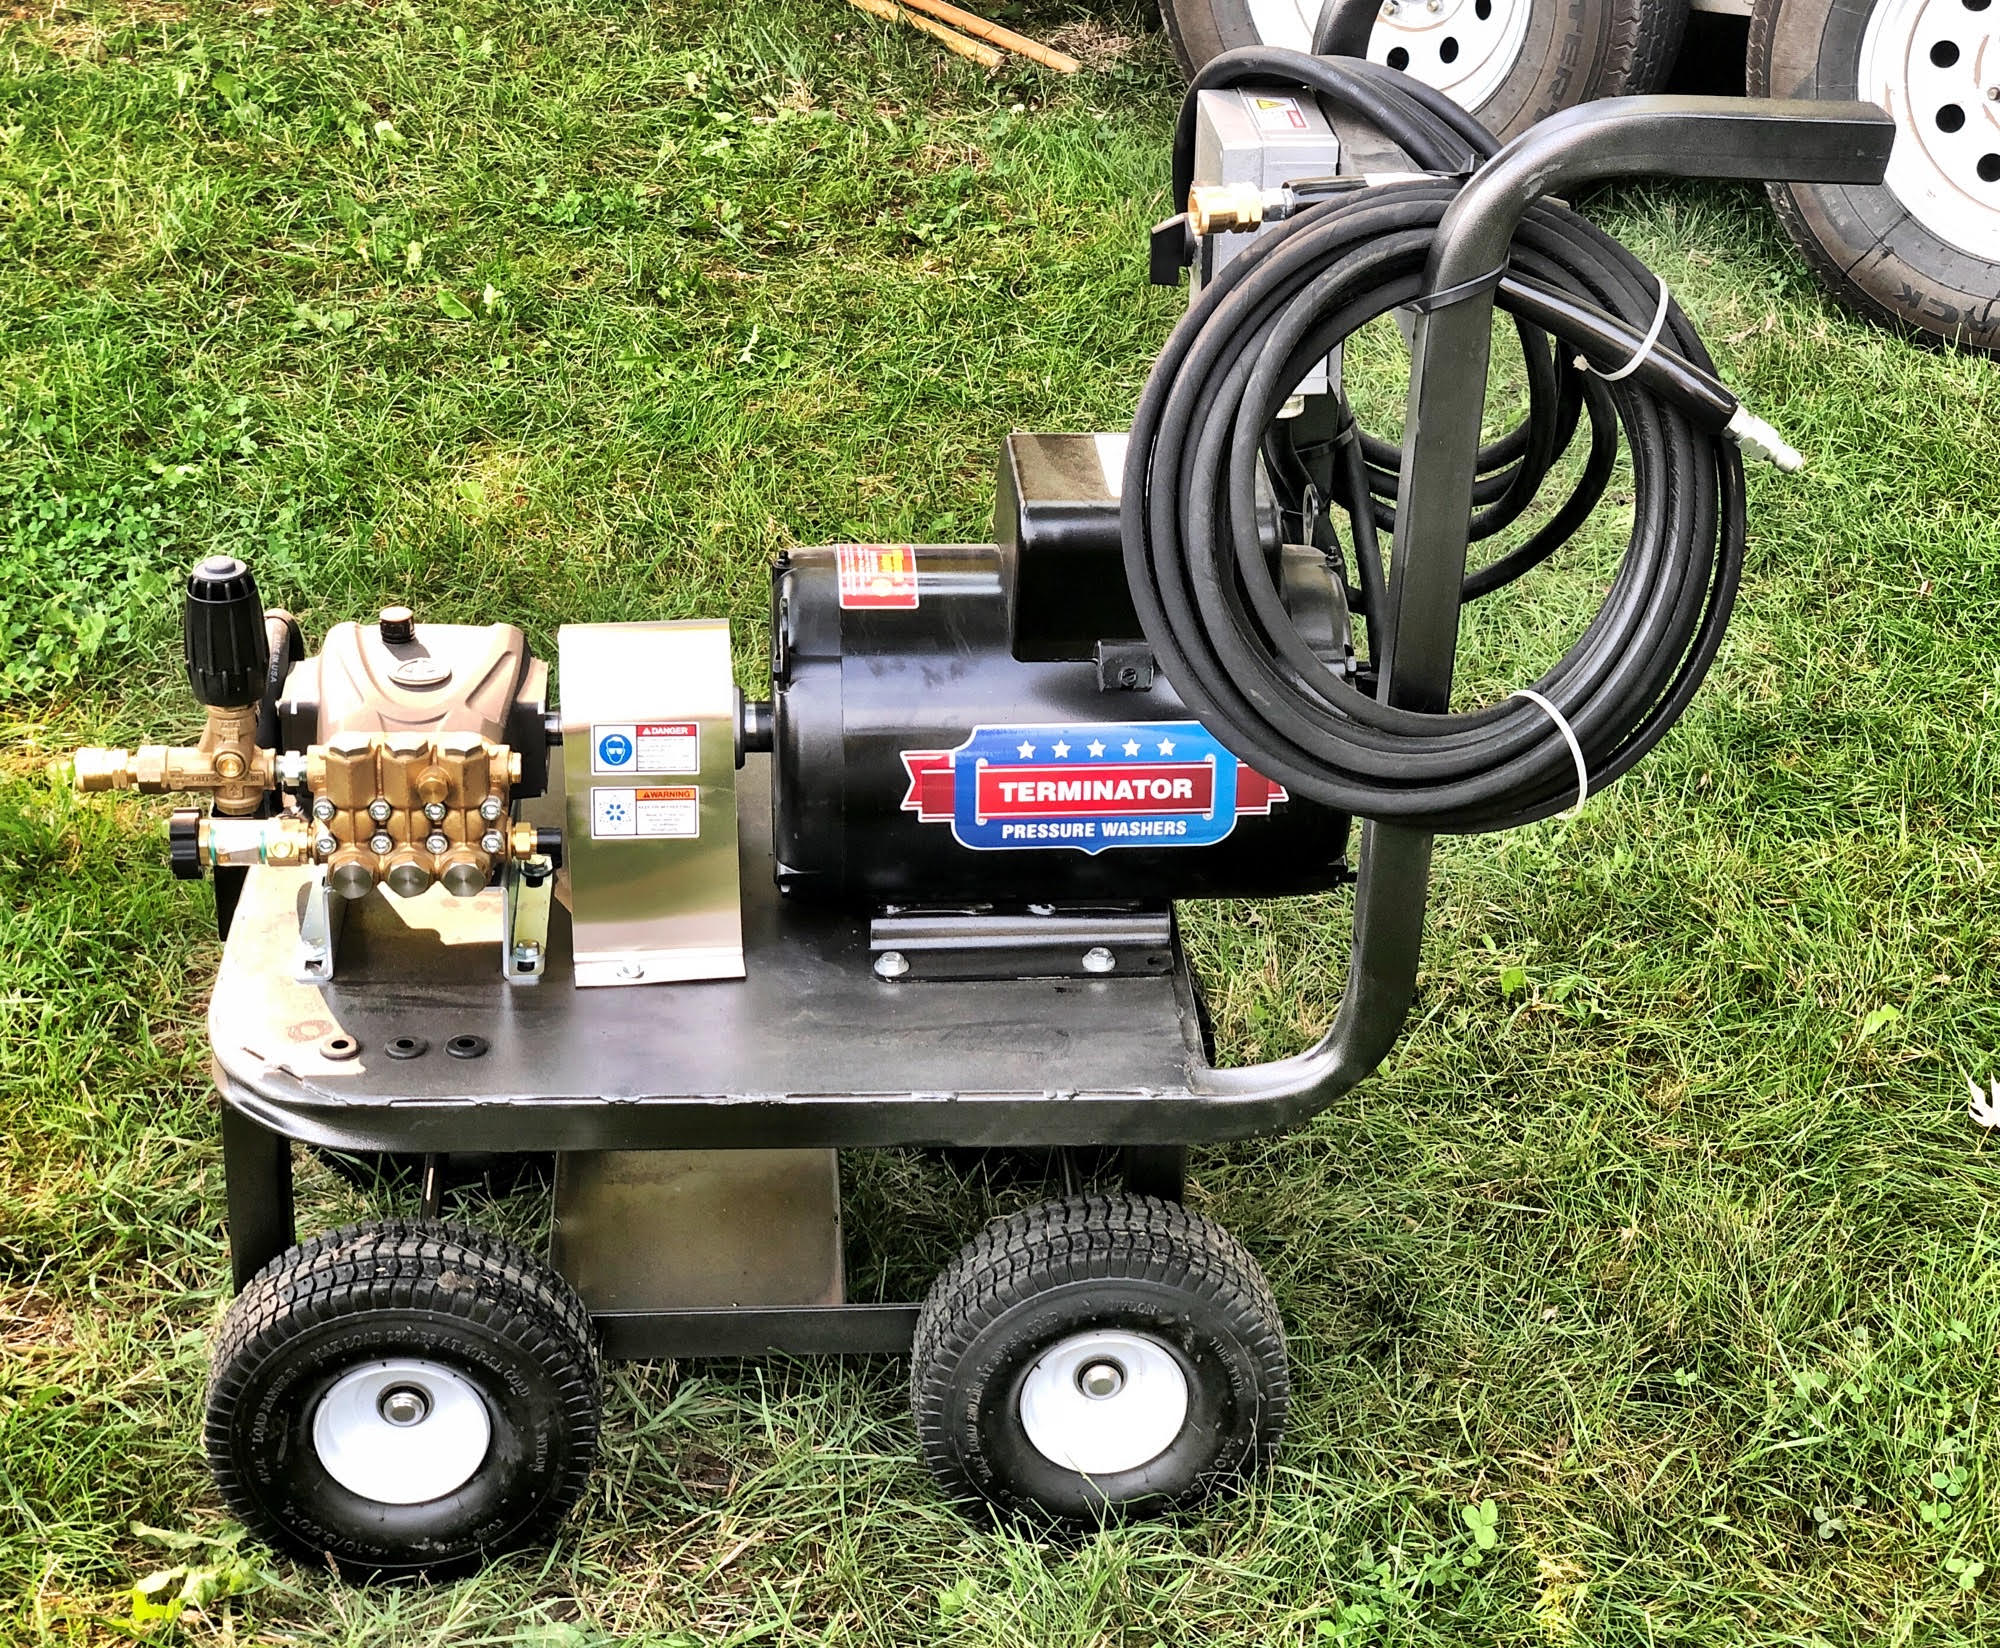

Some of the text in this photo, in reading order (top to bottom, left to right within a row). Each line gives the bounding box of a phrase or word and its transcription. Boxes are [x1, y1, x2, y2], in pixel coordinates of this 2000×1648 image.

[1548, 0, 1585, 112] TER
[270, 664, 279, 683] USA
[651, 727, 688, 735] DANGER
[999, 778, 1193, 803] TERMINATOR
[1002, 820, 1187, 839] PRESSURE WASHERS
[307, 1339, 343, 1362] MAX
[341, 1331, 382, 1349] LOAD
[439, 1335, 461, 1350] AT
[503, 1370, 531, 1398] COLD
[251, 1411, 268, 1442] LOAD
[965, 1425, 980, 1452] LOAD
[531, 1431, 547, 1473] NYLON
